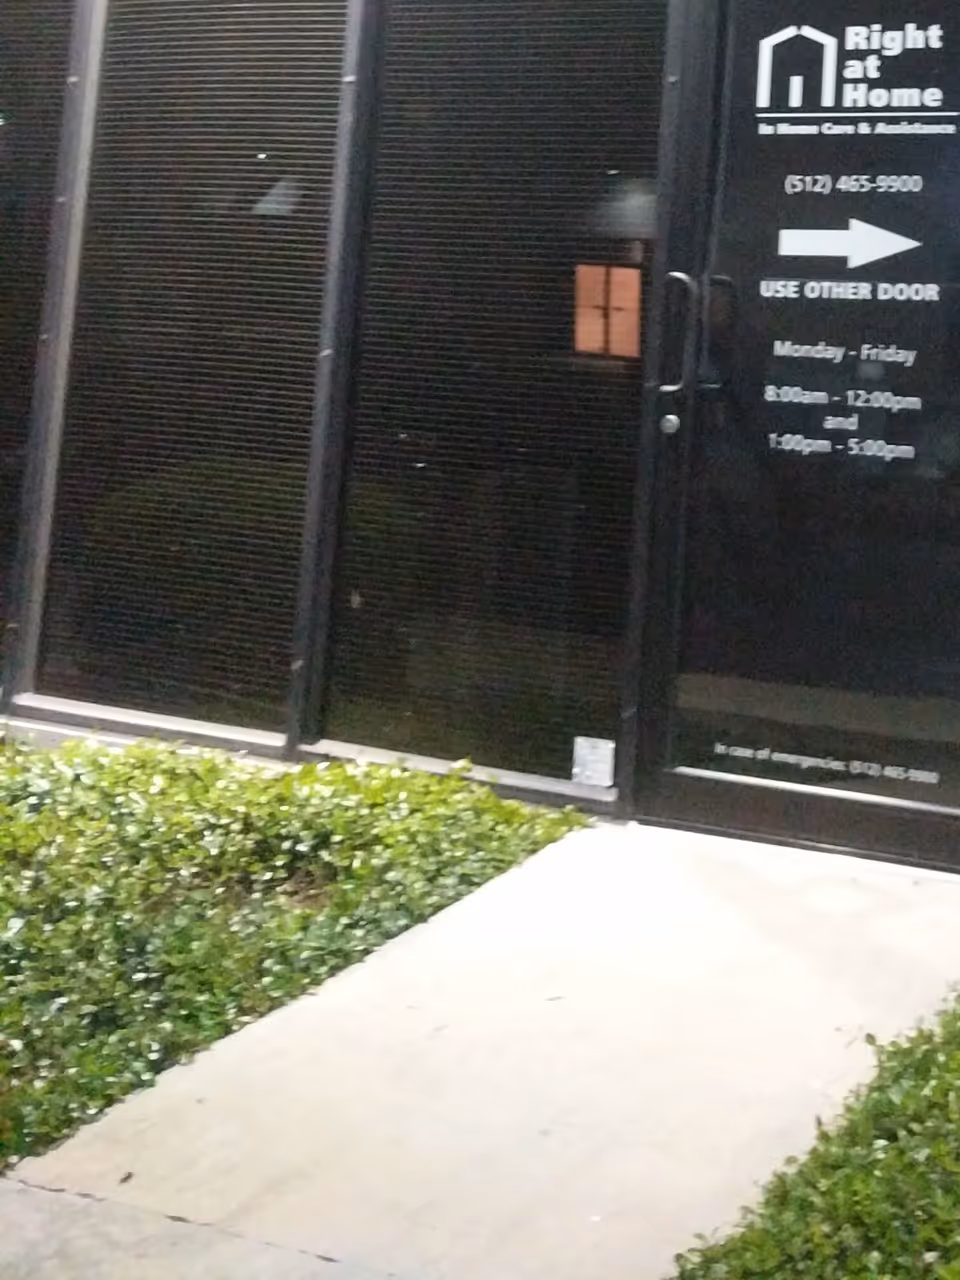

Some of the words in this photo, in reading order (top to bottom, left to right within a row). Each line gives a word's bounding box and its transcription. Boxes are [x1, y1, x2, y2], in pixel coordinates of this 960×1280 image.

[844, 23, 944, 56] Right
[842, 54, 882, 79] at
[842, 83, 944, 108] Home
[784, 174, 832, 195] (512)
[759, 280, 800, 298] USE
[803, 281, 872, 300] OTHER
[876, 282, 940, 301] DOOR
[773, 339, 847, 363] Monday
[860, 344, 918, 367] Friday
